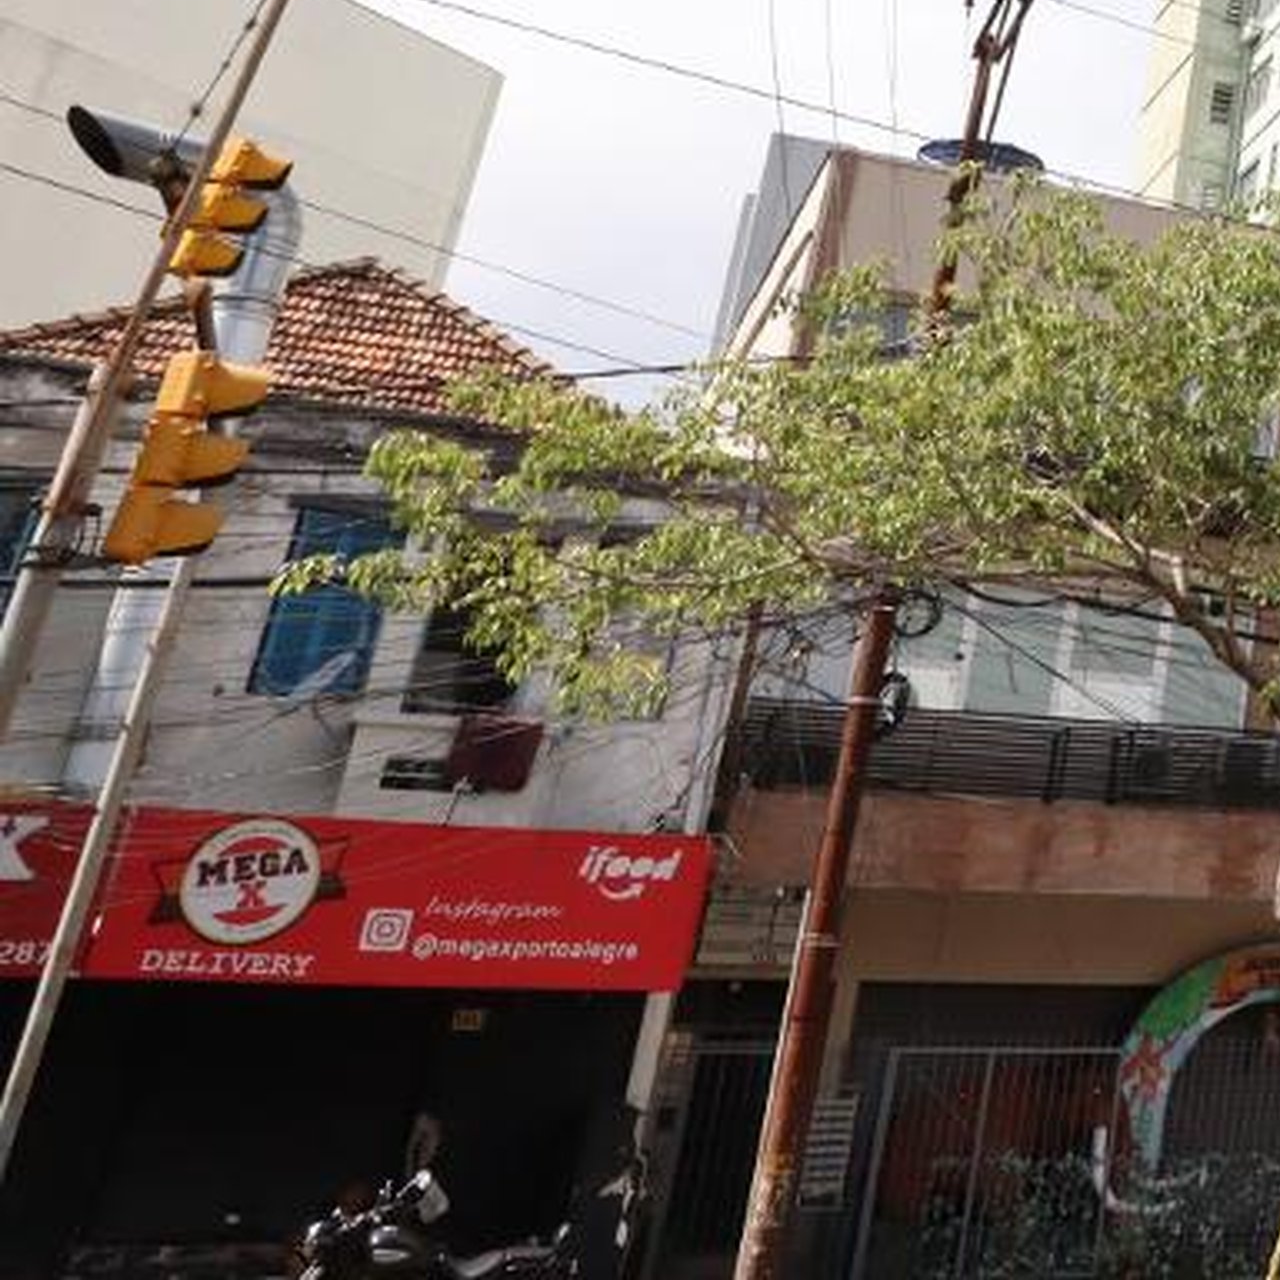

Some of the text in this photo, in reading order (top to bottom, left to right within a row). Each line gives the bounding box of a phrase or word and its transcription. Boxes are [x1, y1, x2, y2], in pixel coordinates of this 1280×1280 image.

[196, 848, 310, 888] MEGA
[579, 846, 683, 883] ifood
[235, 881, 268, 909] X
[424, 896, 564, 924] Instagram
[140, 949, 314, 977] DELIVERY
[412, 932, 640, 965] @megaxportoalegre
